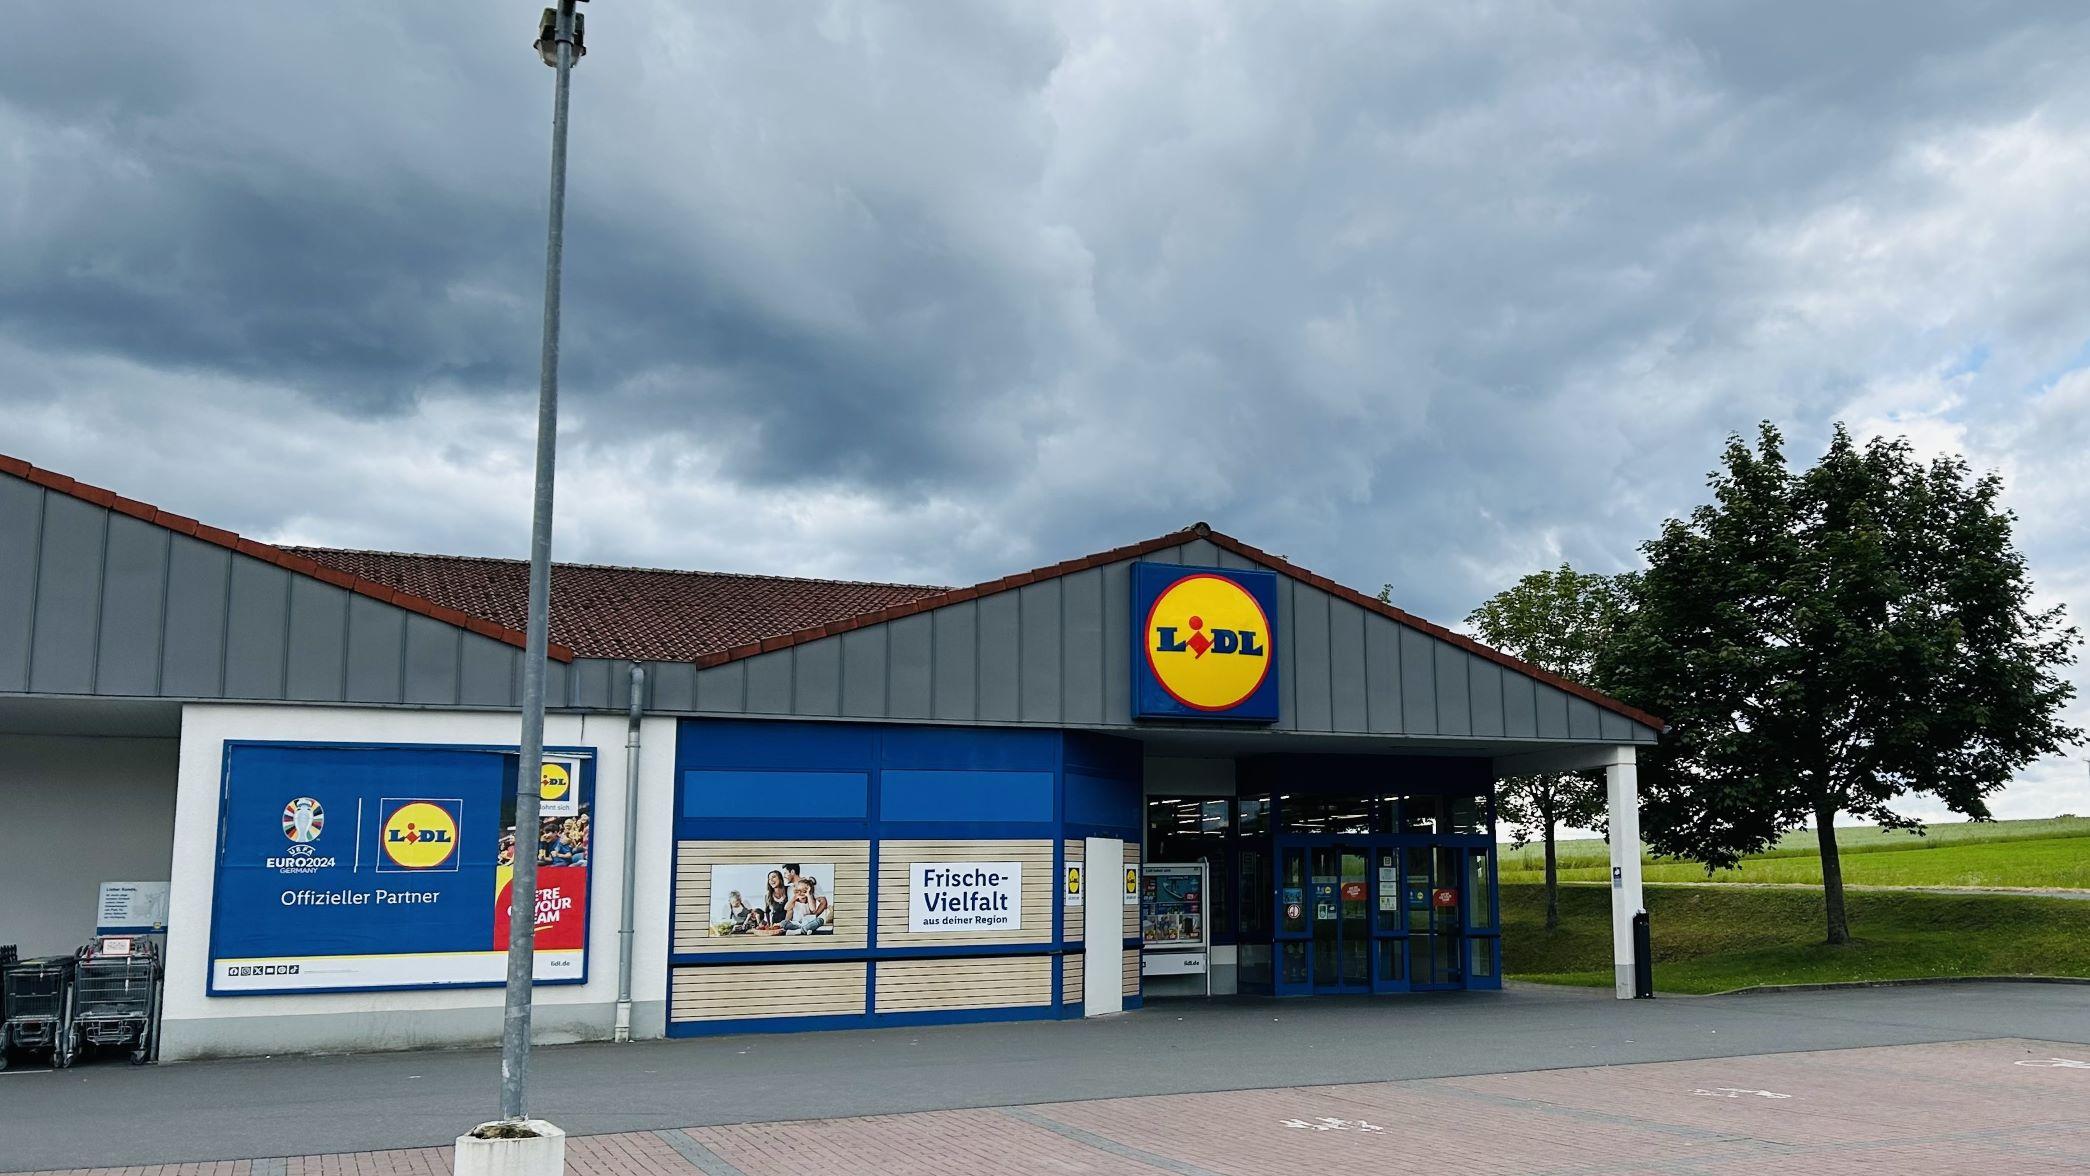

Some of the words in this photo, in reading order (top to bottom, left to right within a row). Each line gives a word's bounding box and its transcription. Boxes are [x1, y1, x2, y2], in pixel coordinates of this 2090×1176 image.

[288, 846, 314, 857] UEFA
[279, 867, 319, 875] GERMANY
[924, 868, 1009, 888] Frische-
[280, 890, 371, 906] Offizieller
[375, 889, 441, 904] Partner
[923, 891, 1009, 912] Vielfalt
[923, 918, 940, 926] aus
[942, 915, 973, 926] deiner
[975, 914, 1008, 926] Region
